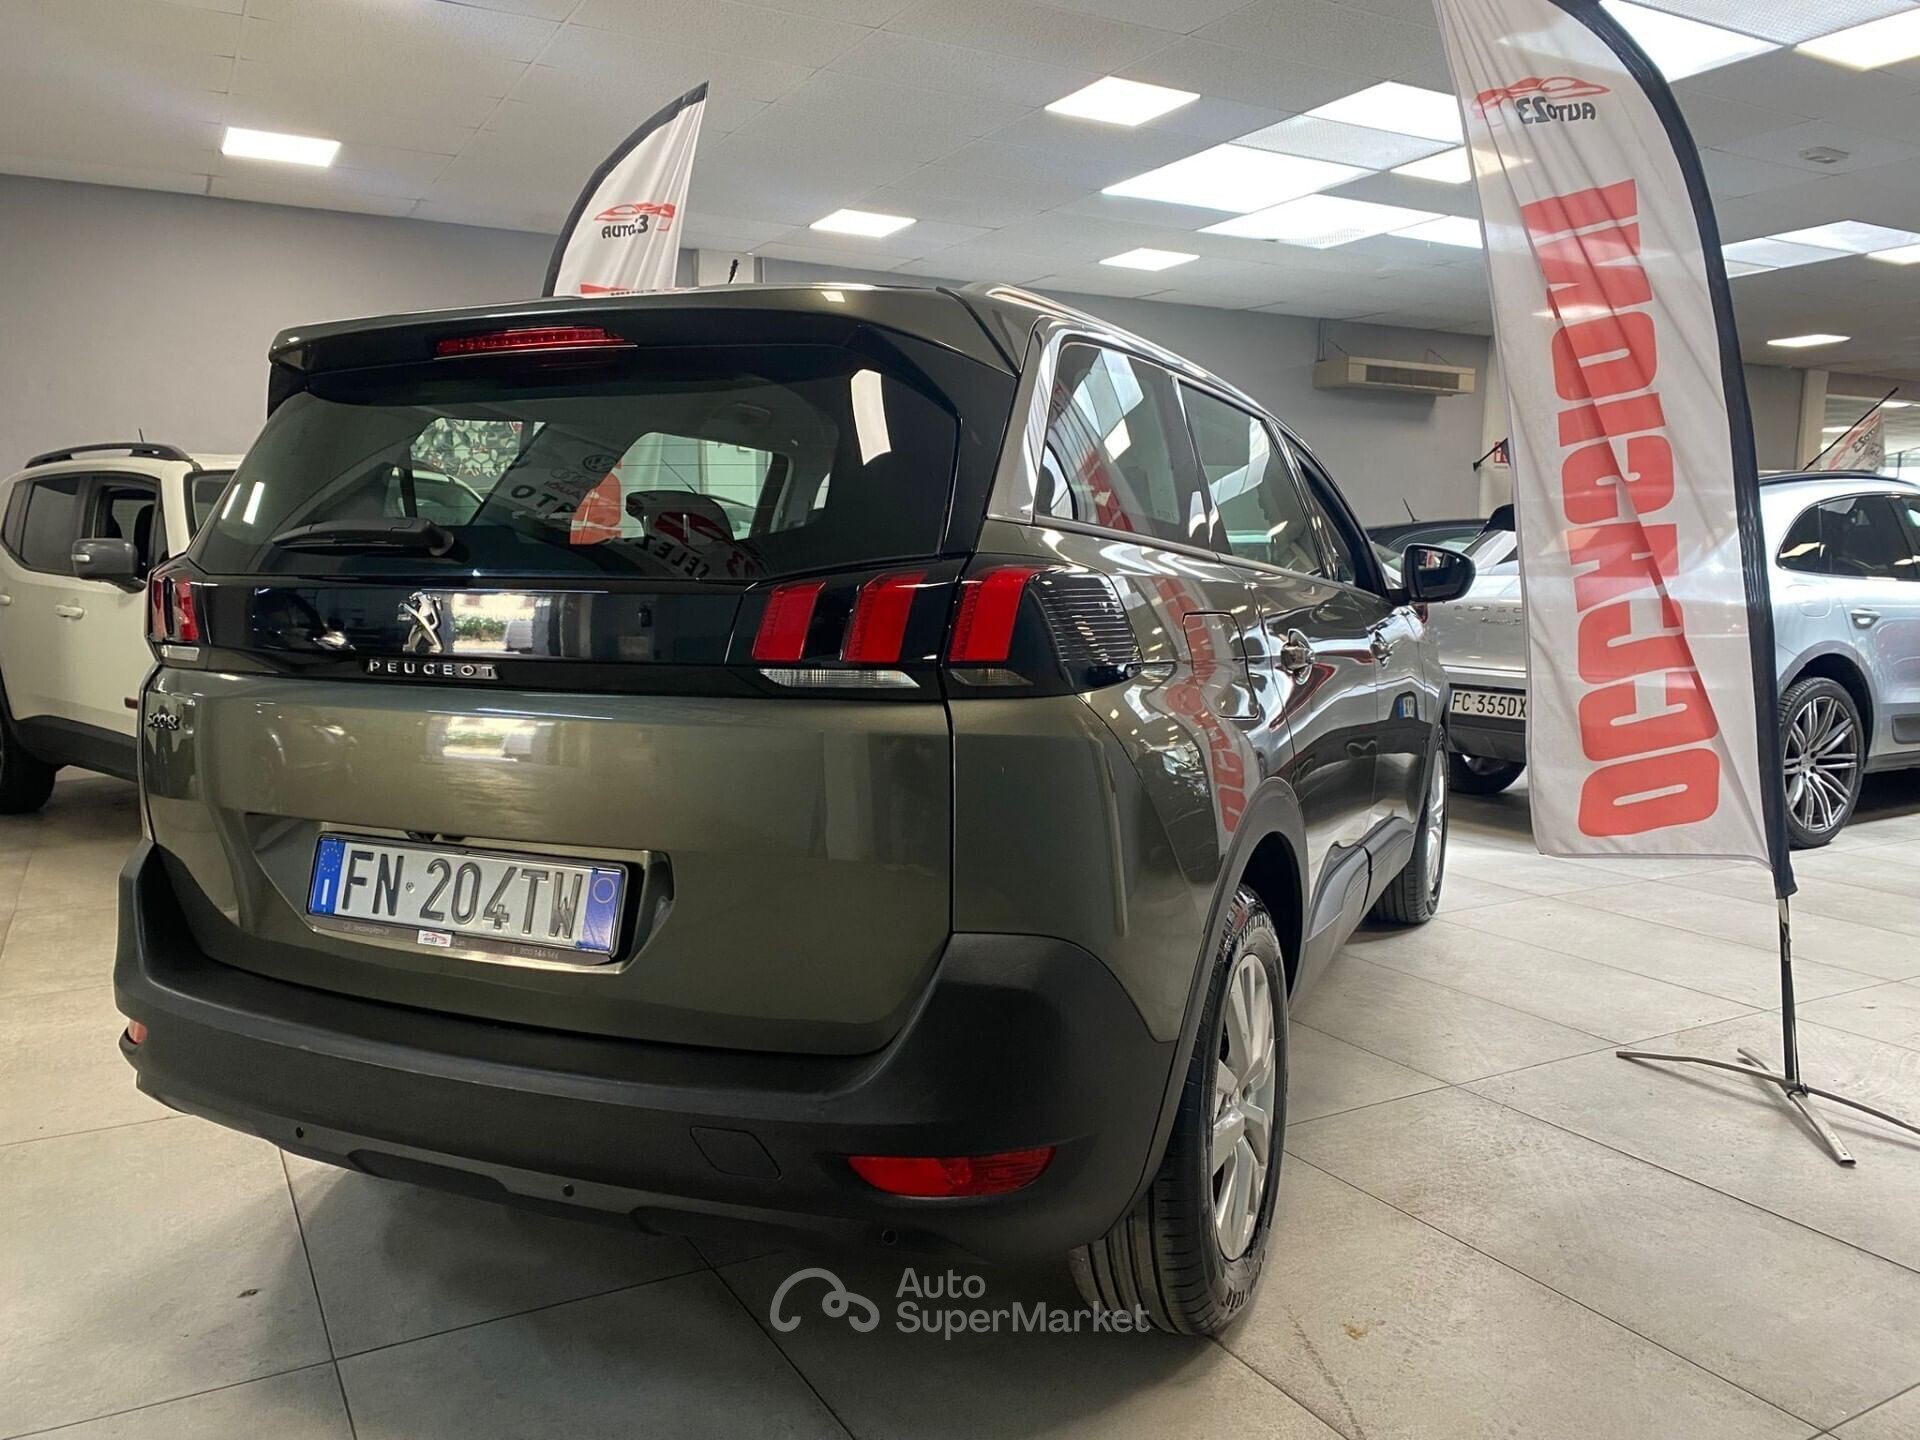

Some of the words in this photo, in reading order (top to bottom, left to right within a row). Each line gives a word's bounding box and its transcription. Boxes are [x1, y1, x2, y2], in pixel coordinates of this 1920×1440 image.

[601, 214, 649, 239] AUTO3
[368, 659, 496, 677] PEUGEOT
[1452, 691, 1472, 712] FC
[1476, 694, 1527, 718] 355DX
[341, 849, 404, 917] FN
[419, 856, 583, 939] 204TW
